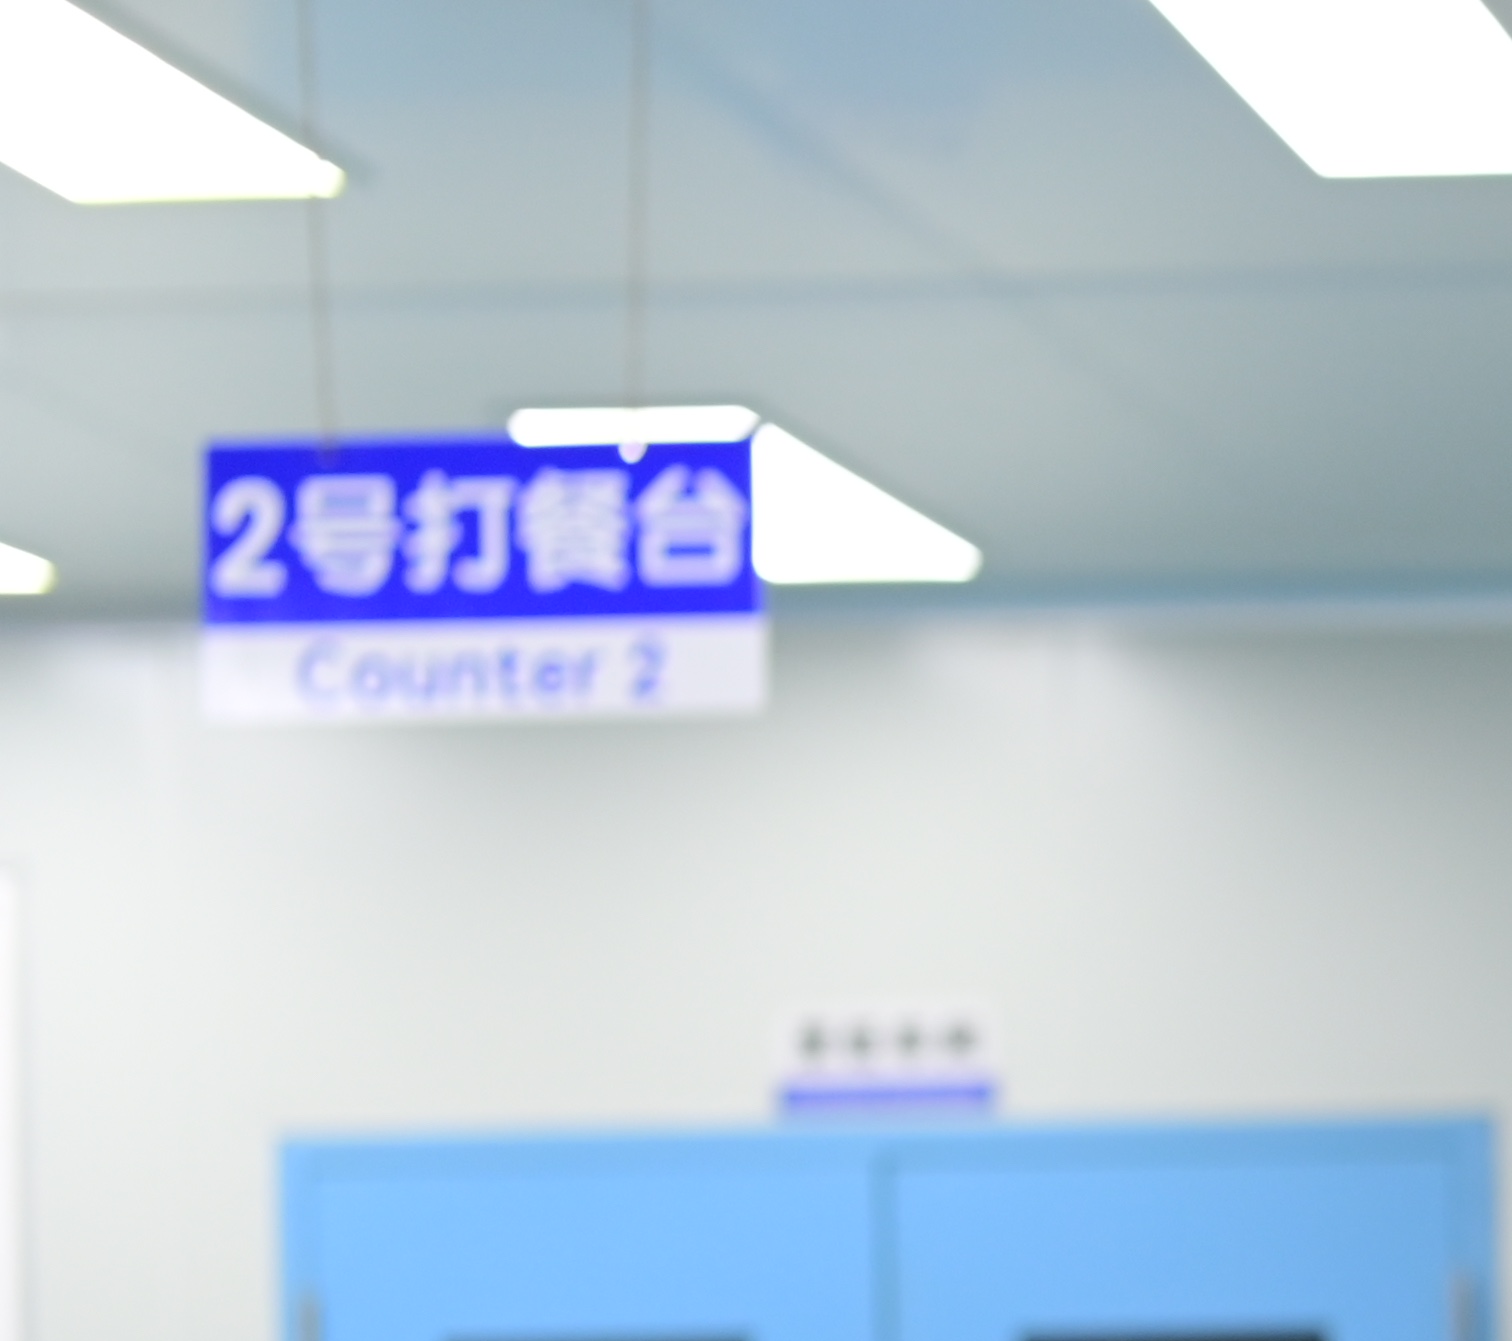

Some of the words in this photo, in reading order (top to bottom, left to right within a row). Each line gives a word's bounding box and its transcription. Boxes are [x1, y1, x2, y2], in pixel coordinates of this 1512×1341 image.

[207, 465, 748, 600] 2号打餐台
[293, 634, 600, 706] Counter
[625, 630, 670, 702] 2
